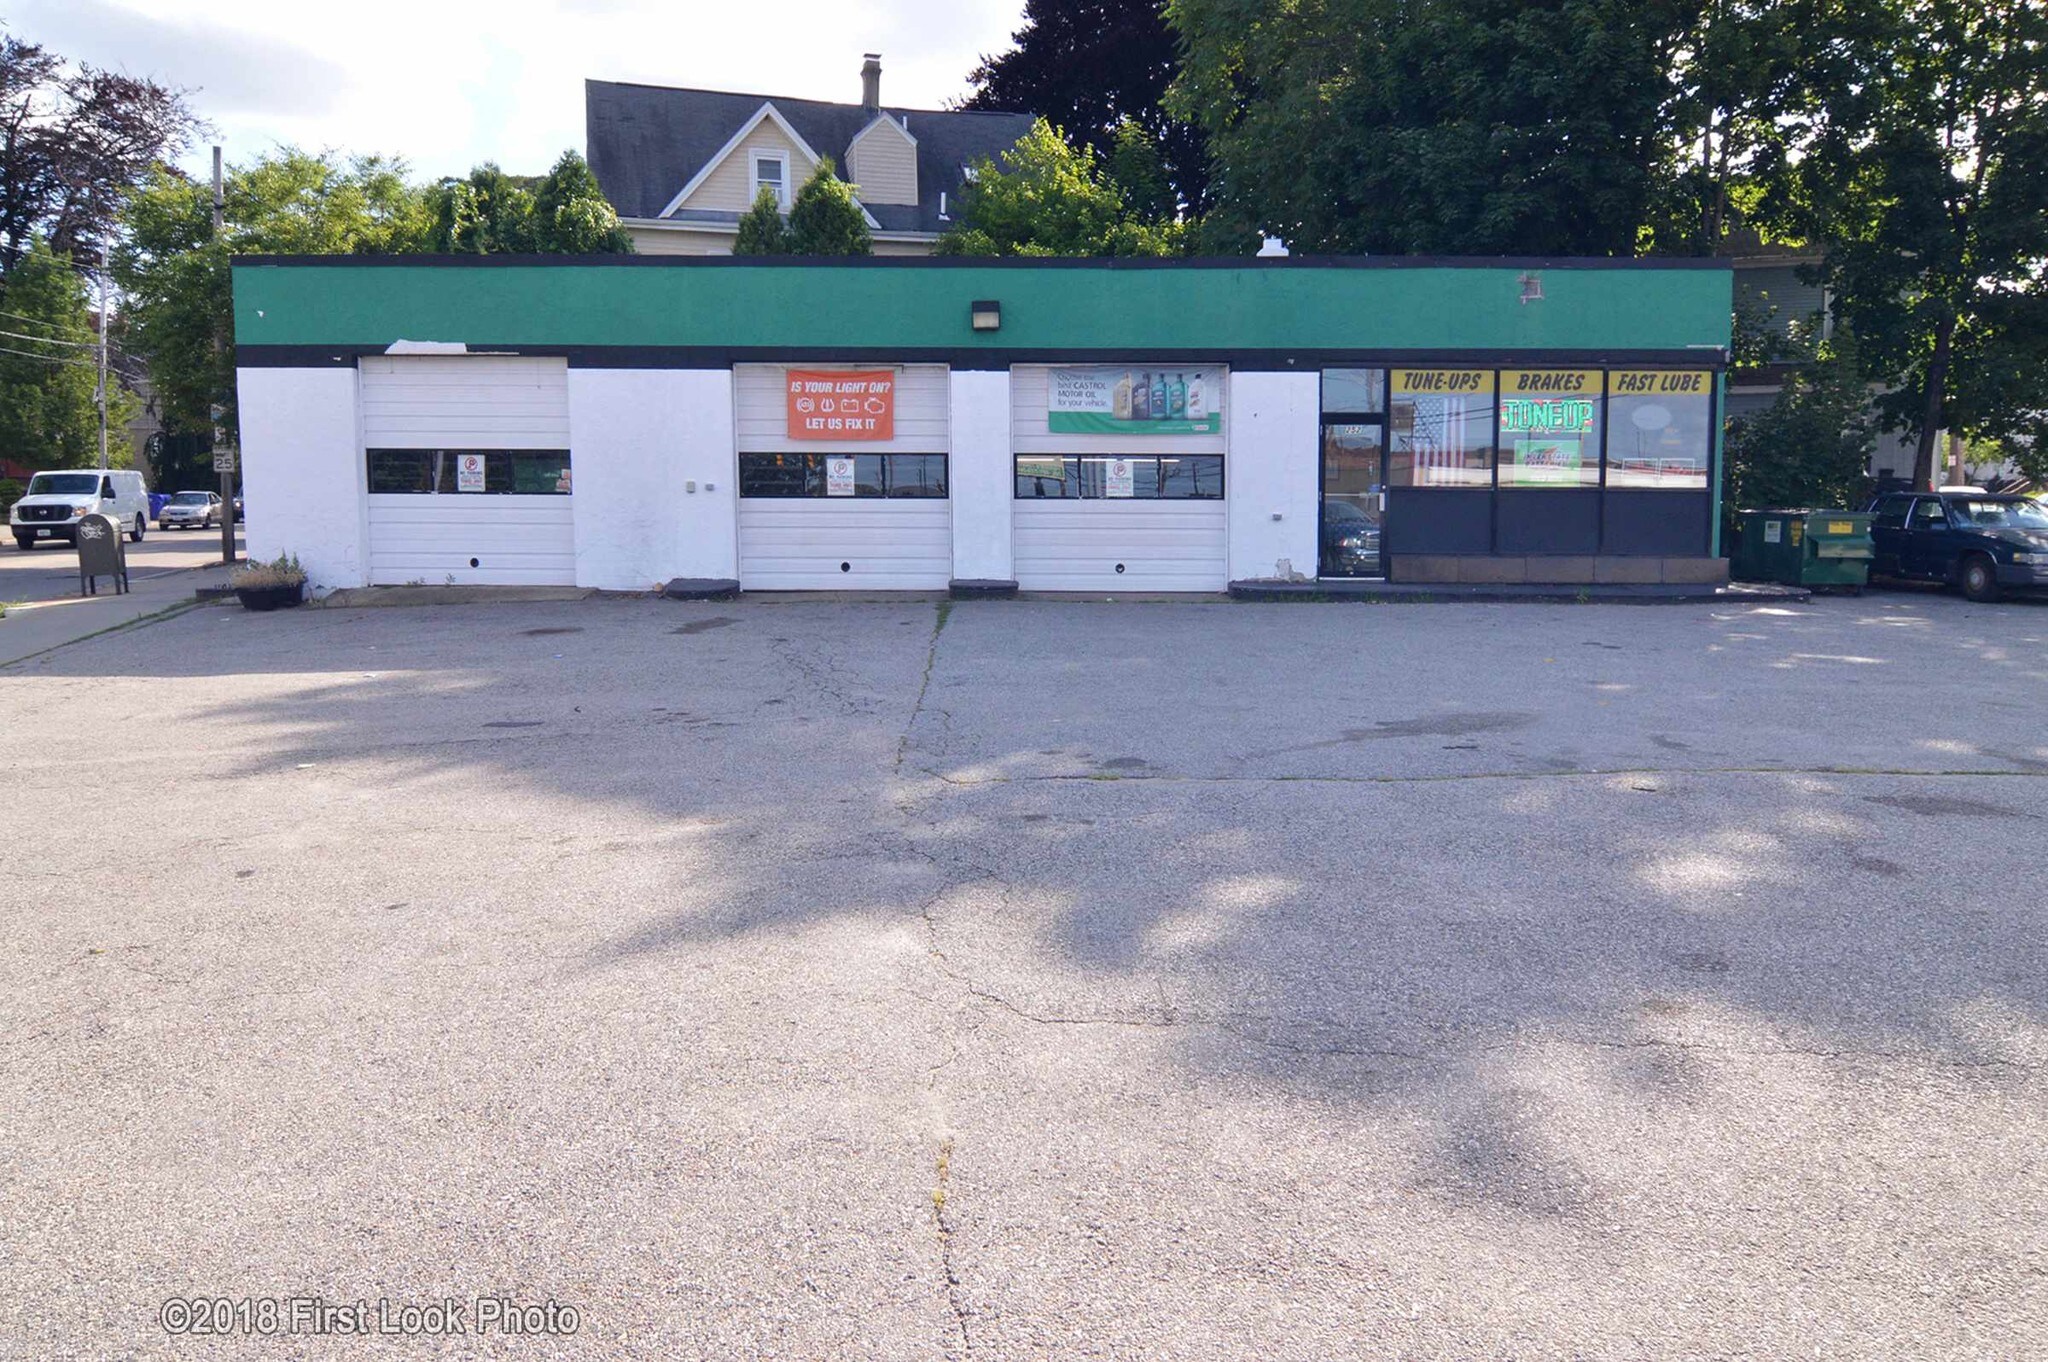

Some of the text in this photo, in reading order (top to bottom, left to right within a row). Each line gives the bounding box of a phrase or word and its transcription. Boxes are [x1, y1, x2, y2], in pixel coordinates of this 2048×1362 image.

[791, 381, 892, 393] IS YOUR LIGHT ON?
[1073, 381, 1106, 390] CASTROL
[1403, 372, 1482, 391] TUNE-UPS
[1517, 373, 1585, 391] BRAKES
[1617, 373, 1701, 392] FAST LUBE
[1058, 390, 1097, 398] MOTOR OIL
[806, 418, 876, 430] LET US FIX IT
[216, 458, 232, 469] 25
